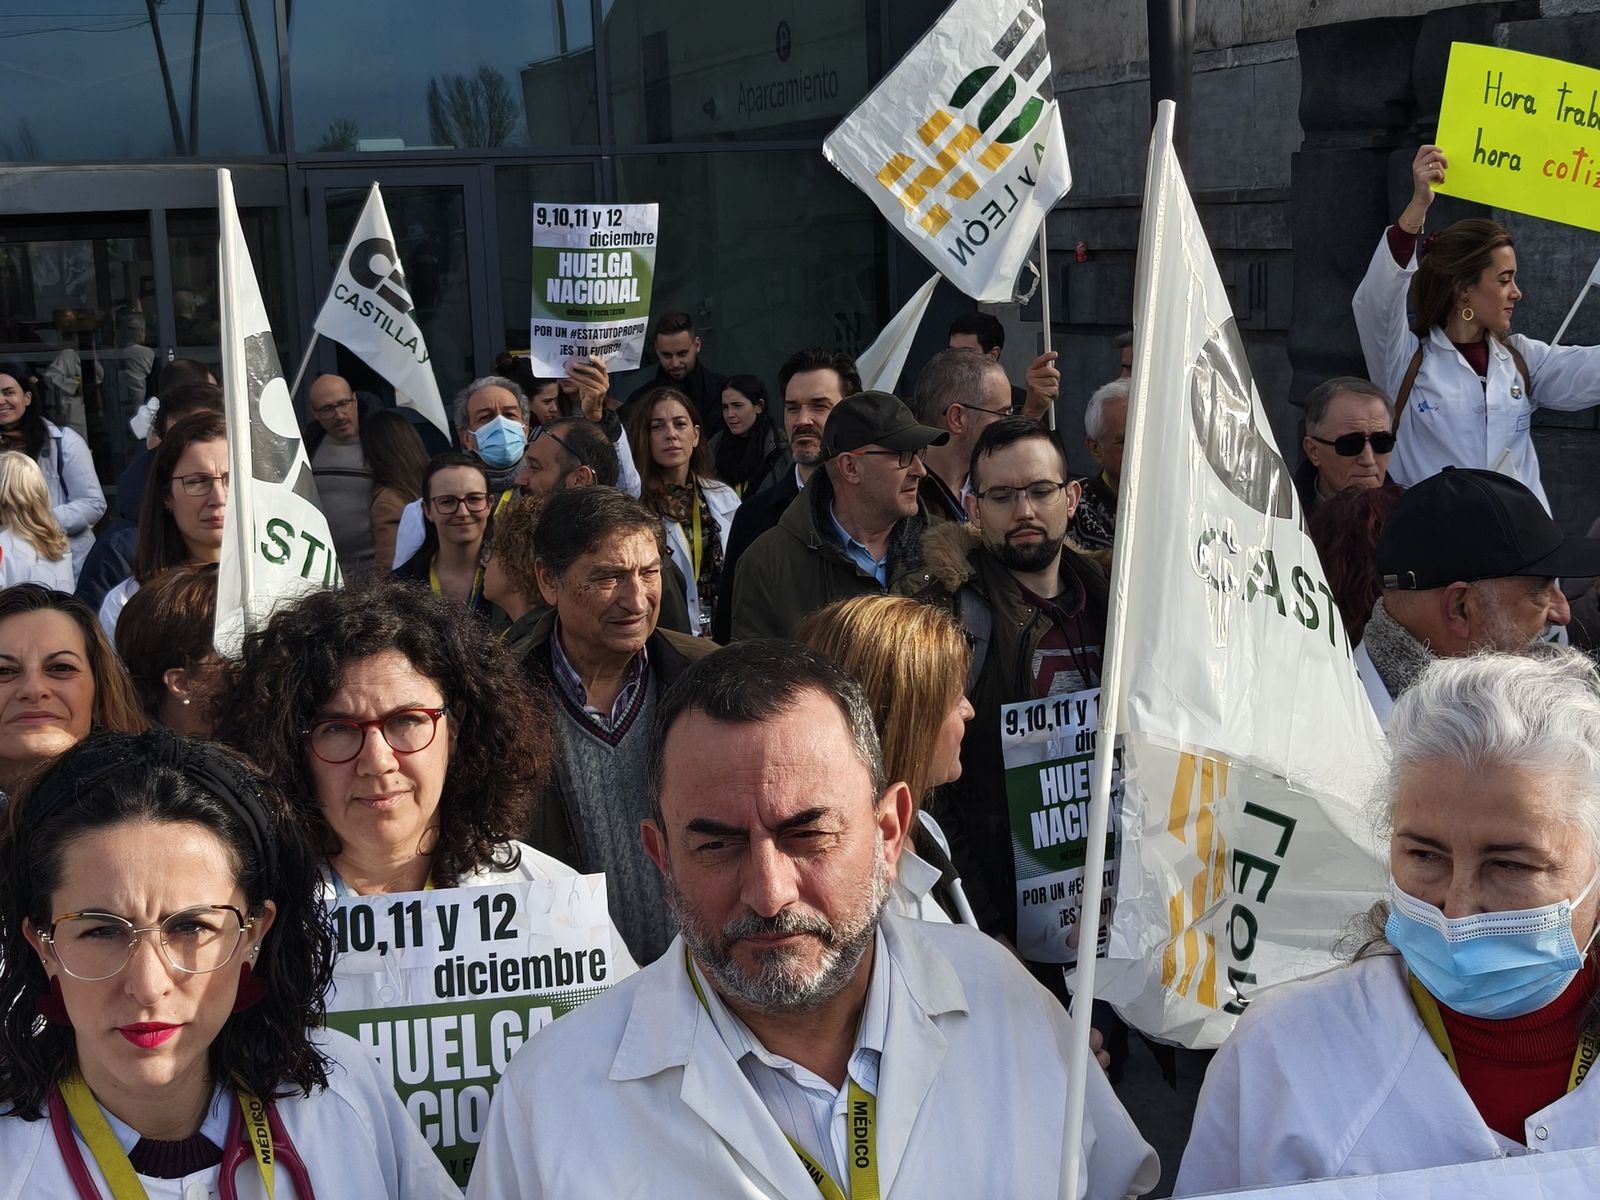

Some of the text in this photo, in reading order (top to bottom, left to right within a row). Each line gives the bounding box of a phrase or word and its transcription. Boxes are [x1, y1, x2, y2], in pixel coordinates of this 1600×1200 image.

[738, 64, 838, 120] Aparcamiento
[1484, 70, 1600, 131] Hora trab
[1473, 127, 1521, 172] hora
[536, 207, 622, 229] 9,10,11 y 12
[590, 231, 654, 247] diciembre
[558, 252, 633, 278] HUELGA
[546, 278, 641, 304] NACIONAL
[334, 283, 419, 354] CASTILLA
[534, 323, 645, 340] POR UN #ESTATUTOPROPIO
[577, 345, 588, 357] TU
[1006, 698, 1070, 738] 9,10,11
[1076, 699, 1087, 727] y
[1023, 885, 1048, 907] POR
[1050, 882, 1065, 901] UN
[437, 903, 459, 951] y
[473, 893, 518, 941] 12
[434, 947, 607, 998] diciembre
[249, 1101, 271, 1165] MÉDICO
[853, 1100, 872, 1169] MÉDICO
